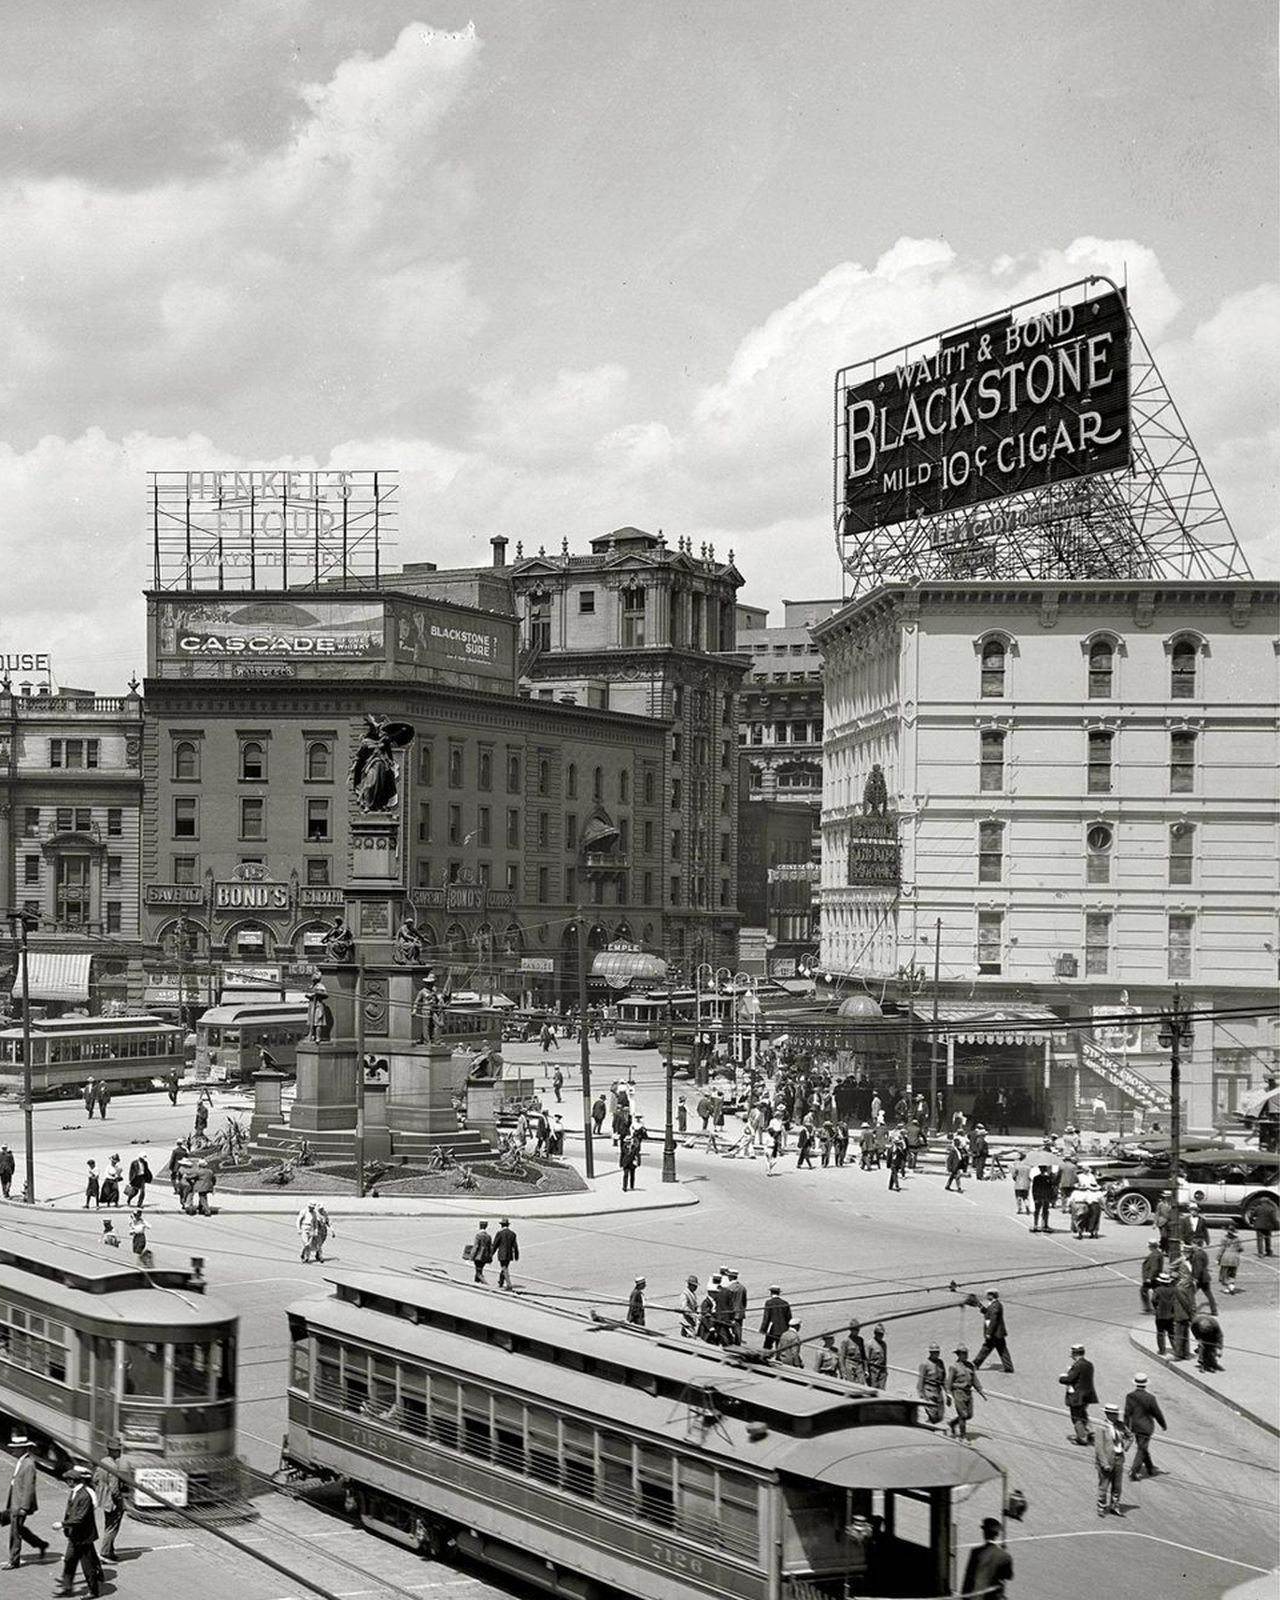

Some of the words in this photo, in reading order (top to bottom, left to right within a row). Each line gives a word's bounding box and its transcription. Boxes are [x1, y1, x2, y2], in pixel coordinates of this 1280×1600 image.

[895, 341, 970, 391] WAITT
[978, 333, 992, 363] &
[1005, 305, 1076, 355] BOND
[847, 332, 1114, 481] BLACKSTONE
[883, 462, 932, 494] MILD
[996, 411, 1123, 474] CIGAR
[186, 470, 354, 500] HENKEL'S
[217, 508, 336, 539] FLOUR
[930, 526, 955, 548] LEE
[972, 514, 1014, 537] CADY
[263, 551, 296, 567] THE
[179, 635, 337, 652] CASCADE
[430, 625, 490, 646] BLACKSTONE
[465, 642, 490, 657] SURE
[217, 886, 288, 908] BOND'S
[602, 943, 640, 953] TEMPLE
[650, 1542, 704, 1575] 7126
